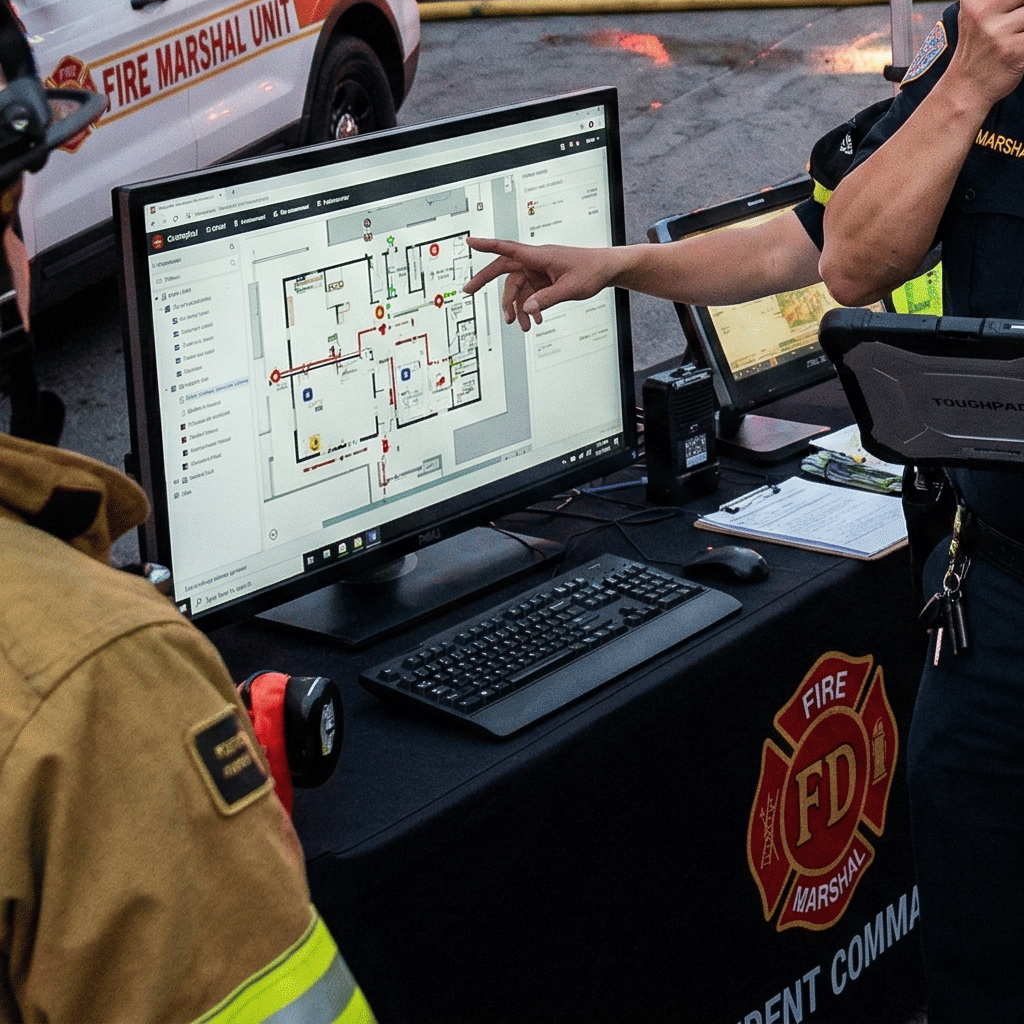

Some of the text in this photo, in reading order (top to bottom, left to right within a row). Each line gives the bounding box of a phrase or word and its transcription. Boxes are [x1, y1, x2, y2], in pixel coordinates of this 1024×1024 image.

[102, 55, 152, 112] FIRE
[156, 30, 248, 91] MARSHAL
[802, 670, 849, 719] FIRE
[794, 742, 857, 848] FD
[792, 848, 866, 914] MARSHAL
